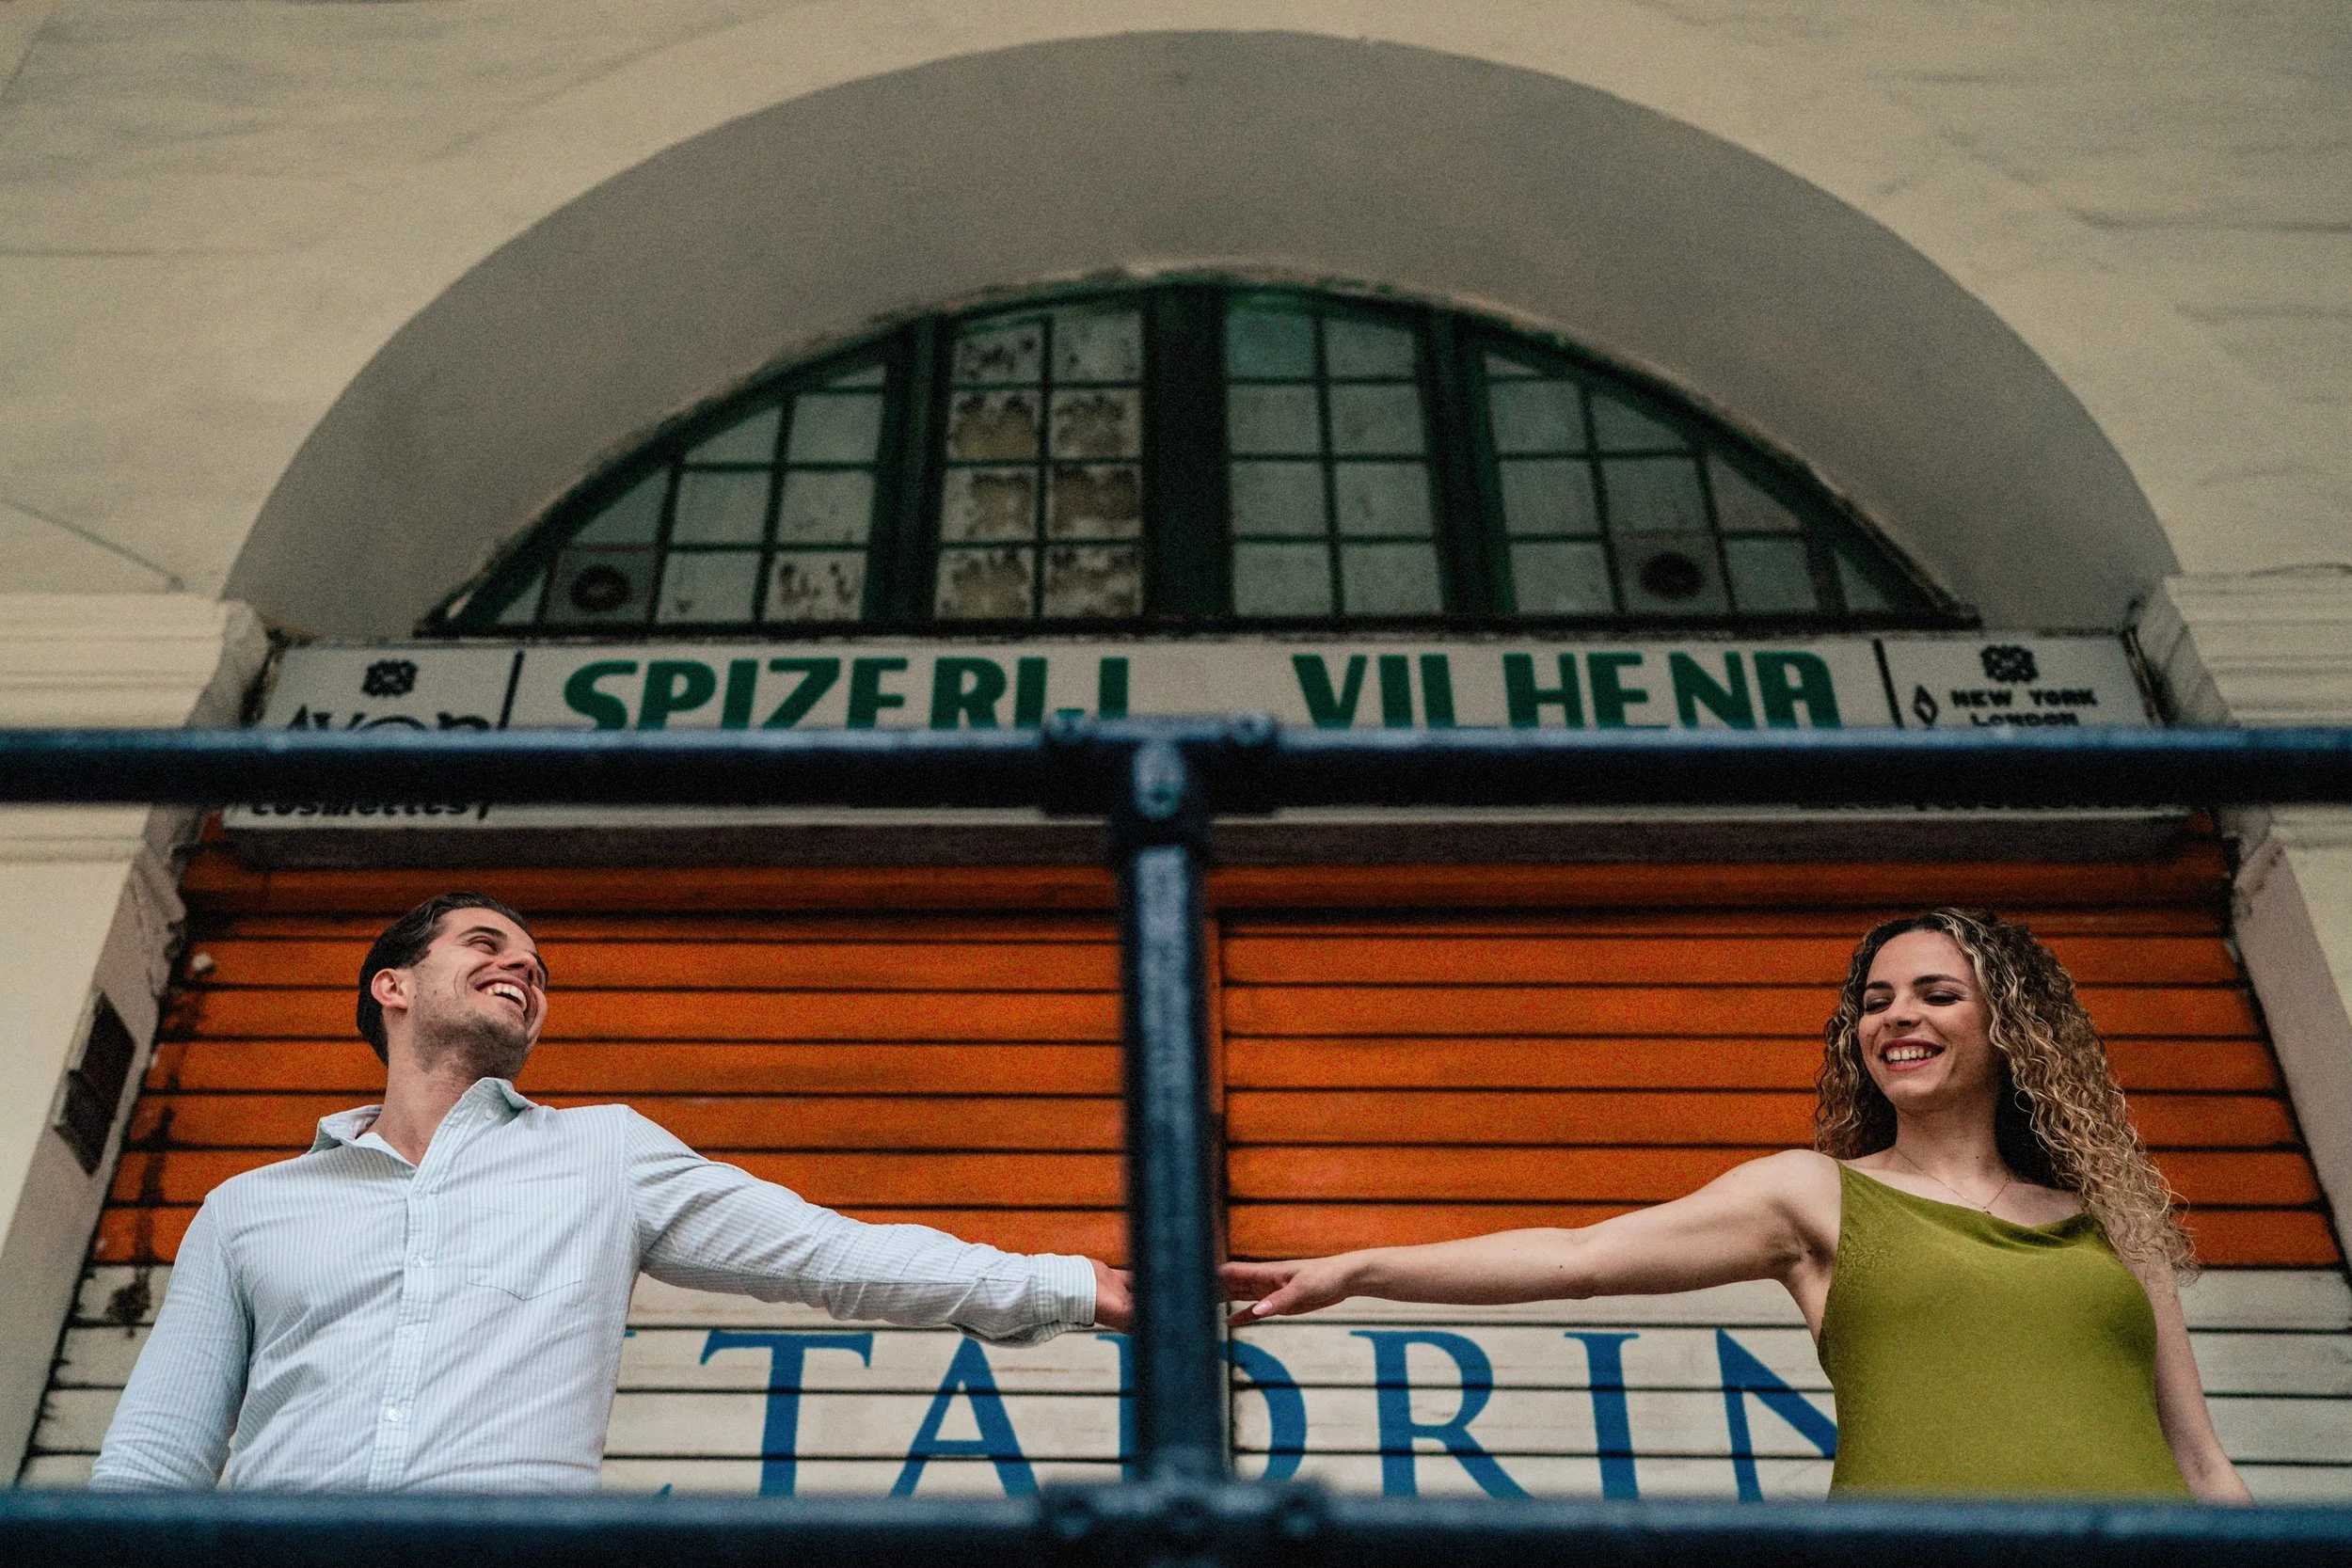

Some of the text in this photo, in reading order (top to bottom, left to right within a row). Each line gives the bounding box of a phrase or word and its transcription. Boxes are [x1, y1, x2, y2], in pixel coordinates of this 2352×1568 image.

[1292, 652, 1842, 729] VILHENA
[1950, 688, 2099, 705] NEW YORK
